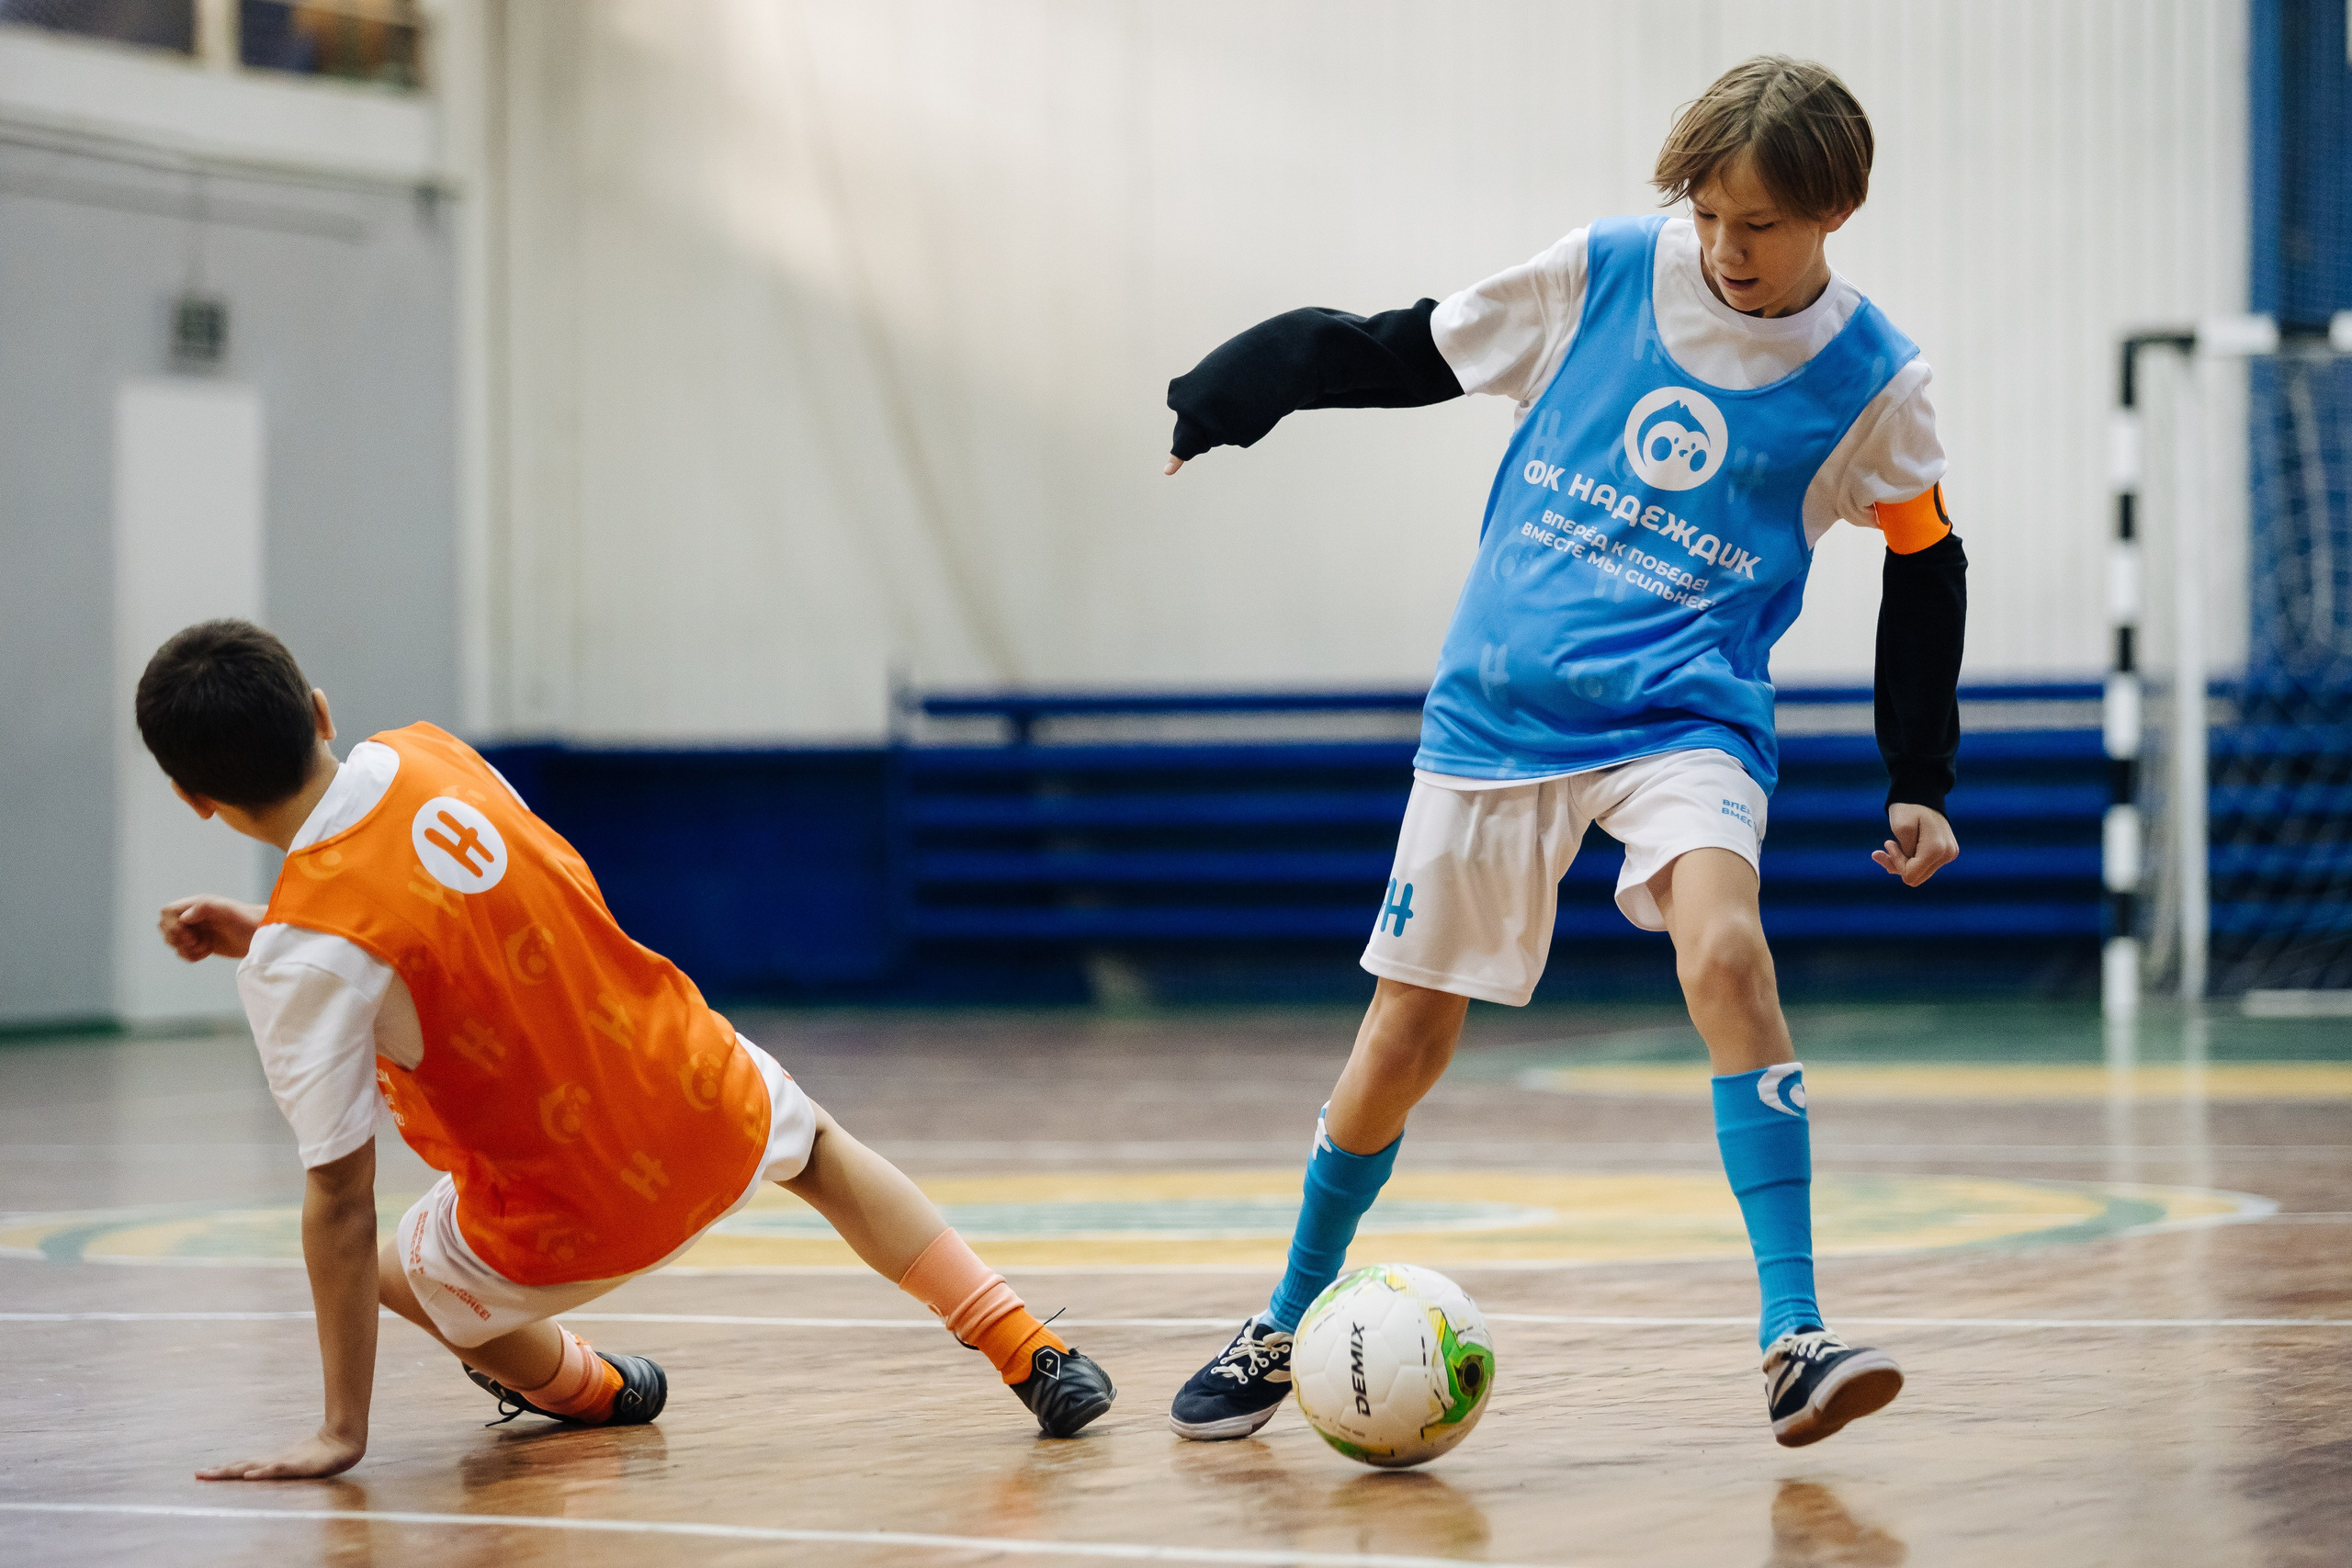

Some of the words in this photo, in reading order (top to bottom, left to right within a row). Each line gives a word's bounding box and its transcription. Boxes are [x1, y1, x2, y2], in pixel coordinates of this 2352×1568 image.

[1521, 521, 1586, 558] ВМЕСТЕ
[1587, 550, 1623, 576] МЫ
[1625, 570, 1716, 611] СИЛЬНЕЕ
[1523, 459, 1566, 491] ФК
[1567, 473, 1762, 581] НАДЕЖДИК
[1541, 509, 1608, 551] ВПЕРЁД
[1611, 541, 1629, 558] К
[1628, 548, 1709, 592] ПОБЕДЕ!
[1351, 1321, 1371, 1417] DEMIX
